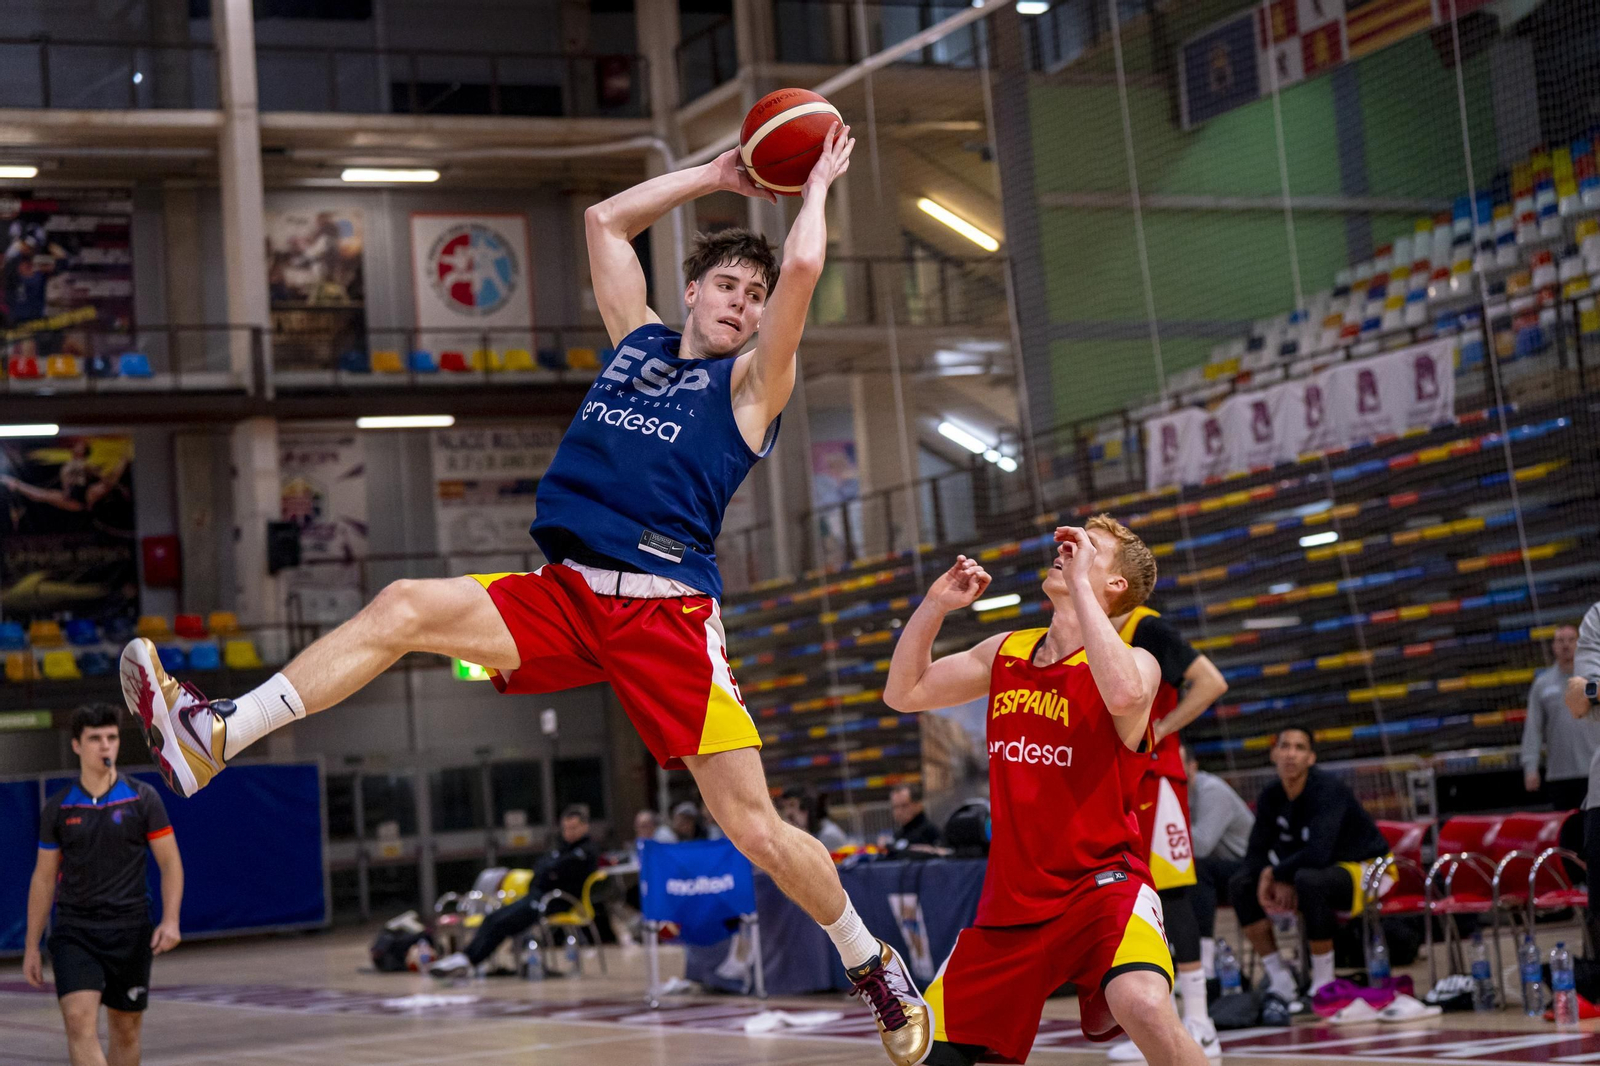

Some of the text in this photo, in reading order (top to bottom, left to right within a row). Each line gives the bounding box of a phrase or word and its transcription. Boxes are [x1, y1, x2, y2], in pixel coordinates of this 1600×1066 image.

[602, 345, 710, 397] ESP
[582, 401, 682, 443] endesa
[992, 688, 1069, 728] ESPAÑA
[1166, 823, 1190, 861] ESP
